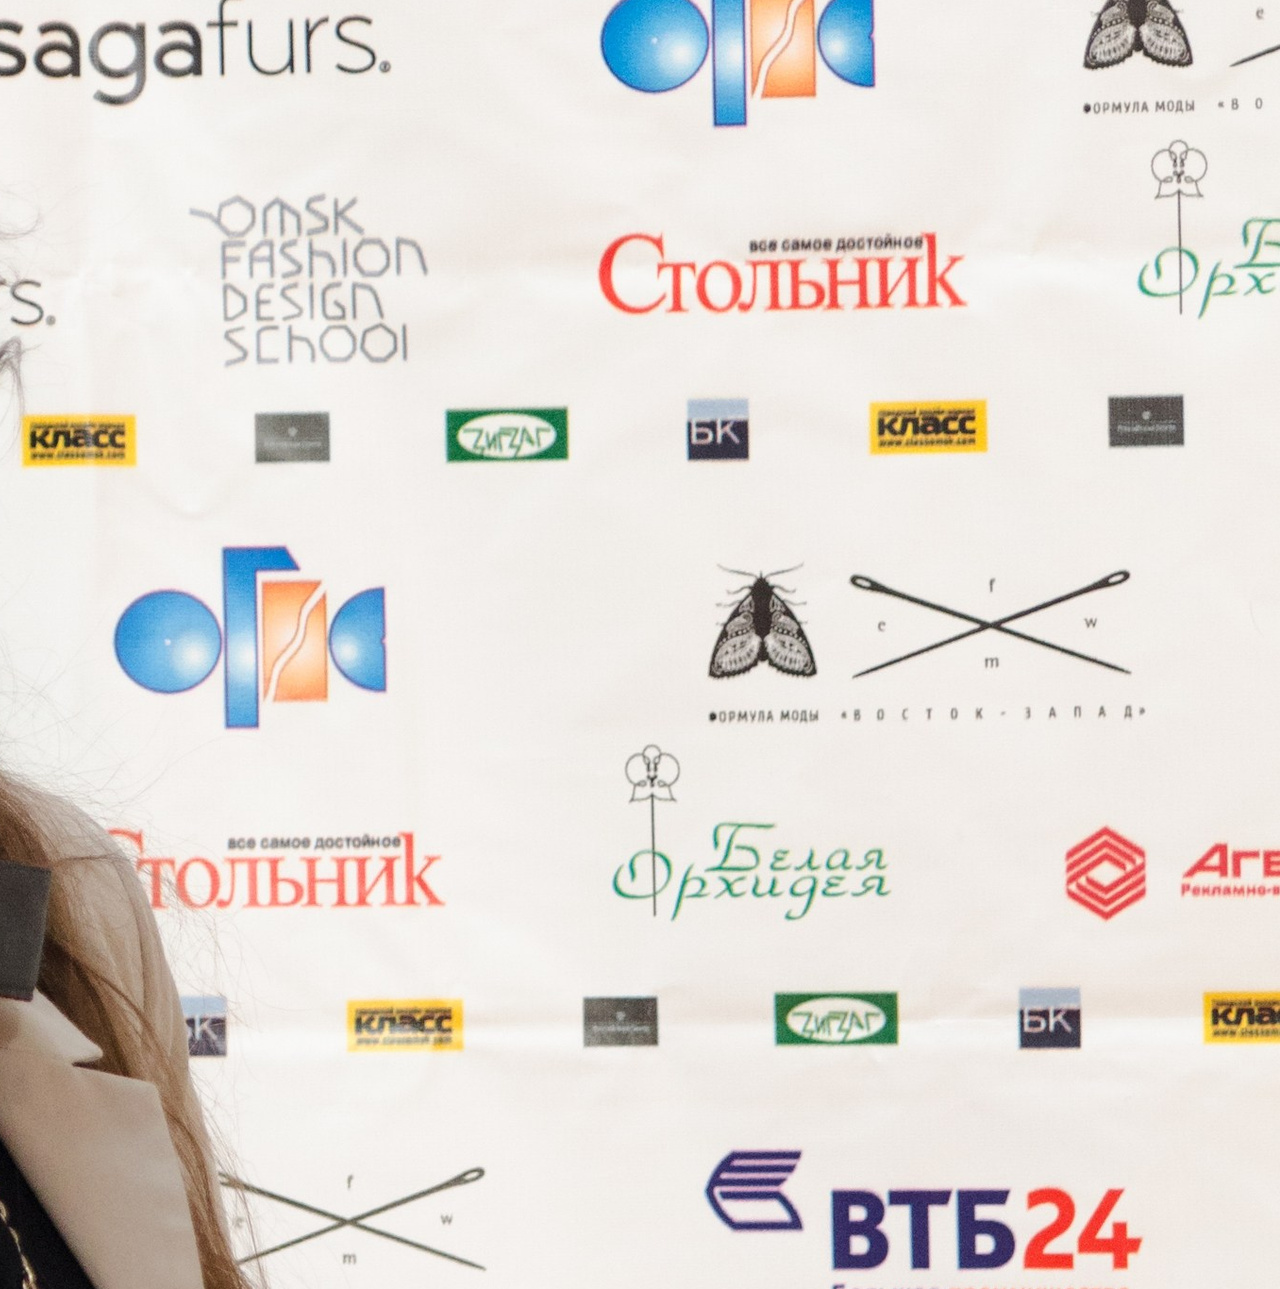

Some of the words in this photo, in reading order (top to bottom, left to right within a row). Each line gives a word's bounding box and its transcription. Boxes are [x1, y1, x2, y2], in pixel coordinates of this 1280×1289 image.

[691, 419, 740, 445] БК
[227, 838, 256, 850] все
[260, 837, 311, 850] самое
[314, 833, 402, 851] достойное
[713, 822, 888, 873] Белая
[1023, 1007, 1072, 1033] БК
[830, 1185, 1144, 1271] ВТБ24
